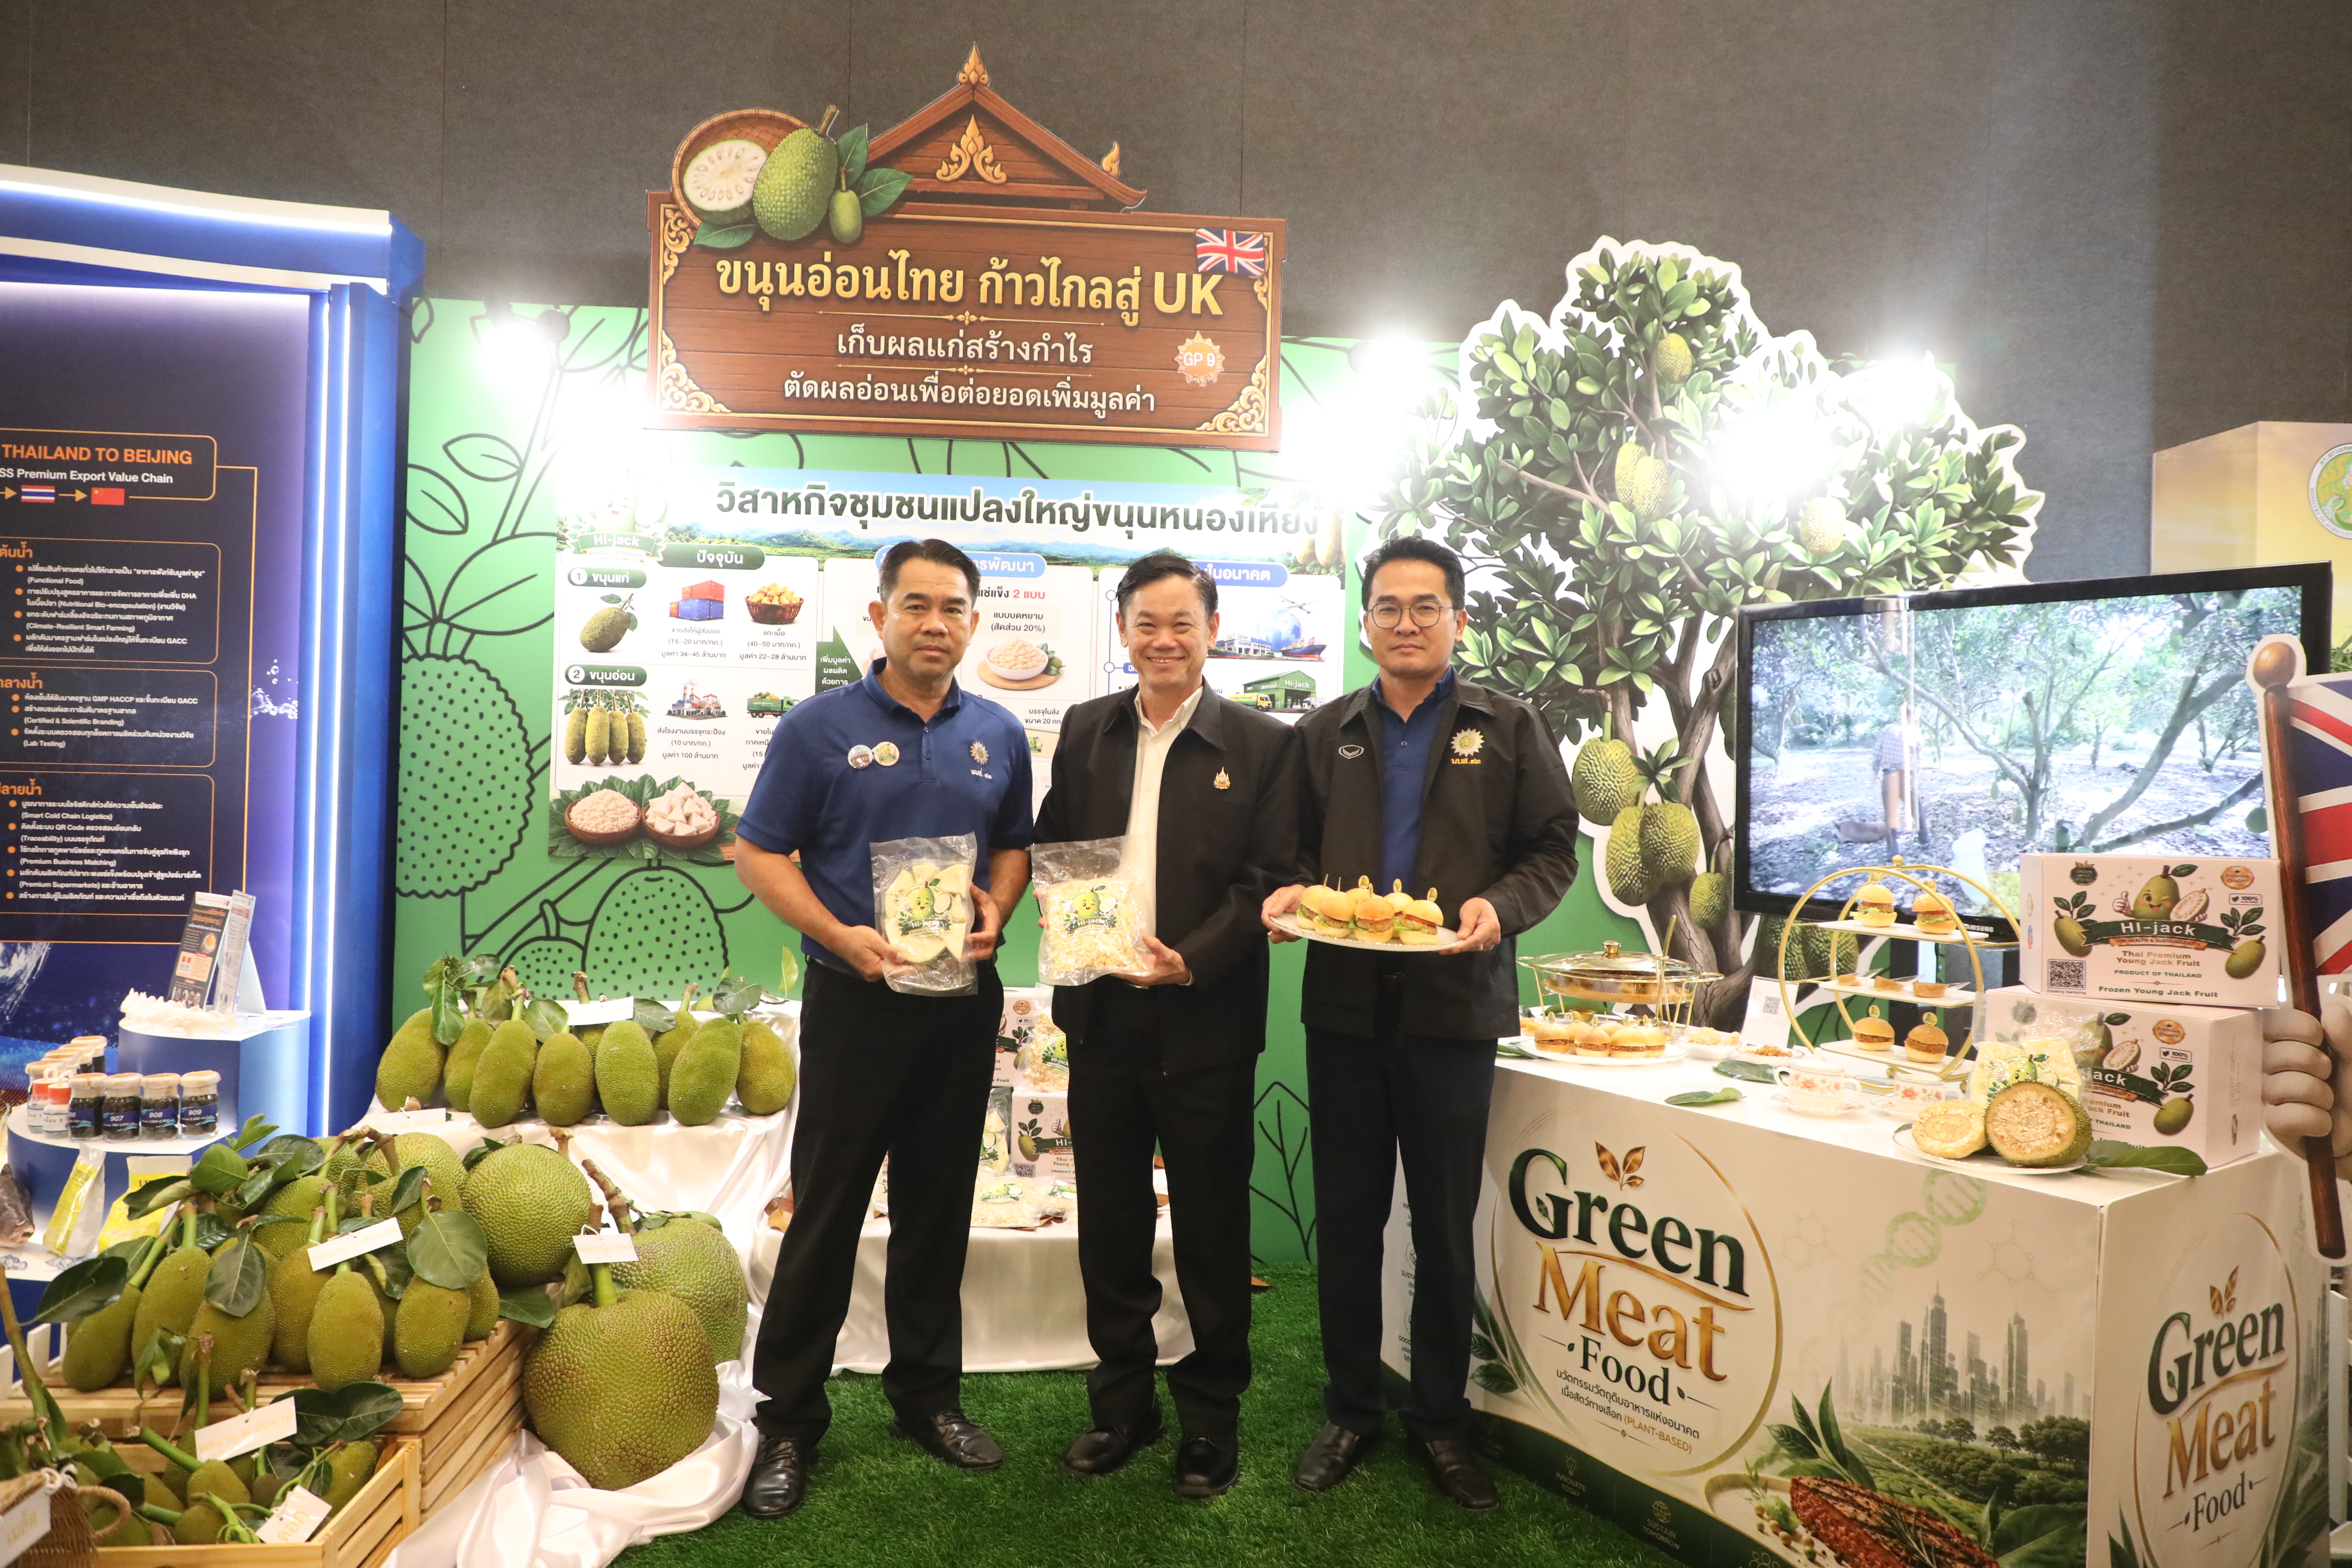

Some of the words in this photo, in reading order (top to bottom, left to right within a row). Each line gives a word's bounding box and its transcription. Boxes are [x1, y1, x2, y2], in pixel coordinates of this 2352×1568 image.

[716, 250, 965, 312] ขนุนอ่อนไทย
[979, 256, 1140, 327] ก้าวไกลสู่
[1154, 271, 1223, 315] UK
[838, 322, 1093, 365] เก็บผลแก่สร้างกำไร
[1182, 351, 1205, 366] GP
[1207, 354, 1216, 367] 9
[783, 369, 1155, 419] ตัดผลอ่อนเพื่อต่อยอดเพิ่มมูลค่า
[2, 444, 91, 461] THAILAND
[95, 447, 119, 462] TO
[124, 448, 193, 465] BEIJING
[17, 468, 67, 480] Premium
[70, 470, 106, 483] Export
[107, 472, 139, 483] Value
[141, 473, 173, 483] Chain
[716, 482, 1318, 540] วิสาหกิจชุมชนแปลงใหญ่ขนุนหนองเหียง
[696, 549, 743, 567] ปัจจุบัน
[65, 577, 84, 586] Food)
[576, 572, 581, 581] 1
[592, 572, 630, 586] ขนุนแก่
[1013, 589, 1020, 598] 2
[1024, 591, 1045, 599] แบบ
[671, 626, 720, 636] ขายส่งให้ผู้ส่งออก
[763, 628, 785, 636] แกะเนื้อ
[991, 622, 1021, 632] (สัดส่วน
[1024, 624, 1046, 633] 20%)
[693, 638, 723, 647] บาท/กก.)
[661, 649, 679, 659] มูลค่า
[701, 650, 726, 659] ล้านบาท
[739, 652, 757, 661] มูลค่า
[820, 654, 851, 665] เพิ่มมูลค่า
[573, 670, 580, 679] 2
[589, 669, 635, 685] ขนุนอ่อน
[1285, 679, 1310, 688] Hi-jack
[657, 726, 726, 737] ส่งโรงงานบรรจุกระป๋อง
[671, 739, 681, 747] (10
[683, 739, 711, 748] บาท/กก.)
[662, 750, 679, 760] มูลค่า
[694, 751, 719, 760] ล้านบาท
[2120, 922, 2196, 936] HI-jack
[2116, 957, 2147, 965] Young
[2134, 987, 2164, 996] Young
[2108, 1109, 2130, 1118] Fruit
[2095, 1119, 2131, 1130] THAILAND
[1508, 1147, 1750, 1298] Green
[1532, 1241, 1728, 1383] Meat
[2148, 1301, 2285, 1415] Green
[1579, 1334, 1672, 1406] Food
[1556, 1369, 1700, 1439] นวัตกรรมวัตถุดิบอาหารแห่งอนาคต
[1561, 1384, 1622, 1422] เนื้อสัตว์ทางเลือก
[1624, 1415, 1692, 1455] (PLANT-BASED)
[2162, 1377, 2277, 1500] Meat
[1555, 1471, 1586, 1493] INNOVATE
[1561, 1483, 1581, 1497] TODAY
[2192, 1471, 2246, 1533] Food
[1646, 1518, 1676, 1540] SUSTAIN
[1642, 1526, 1681, 1551] TOMORROW
